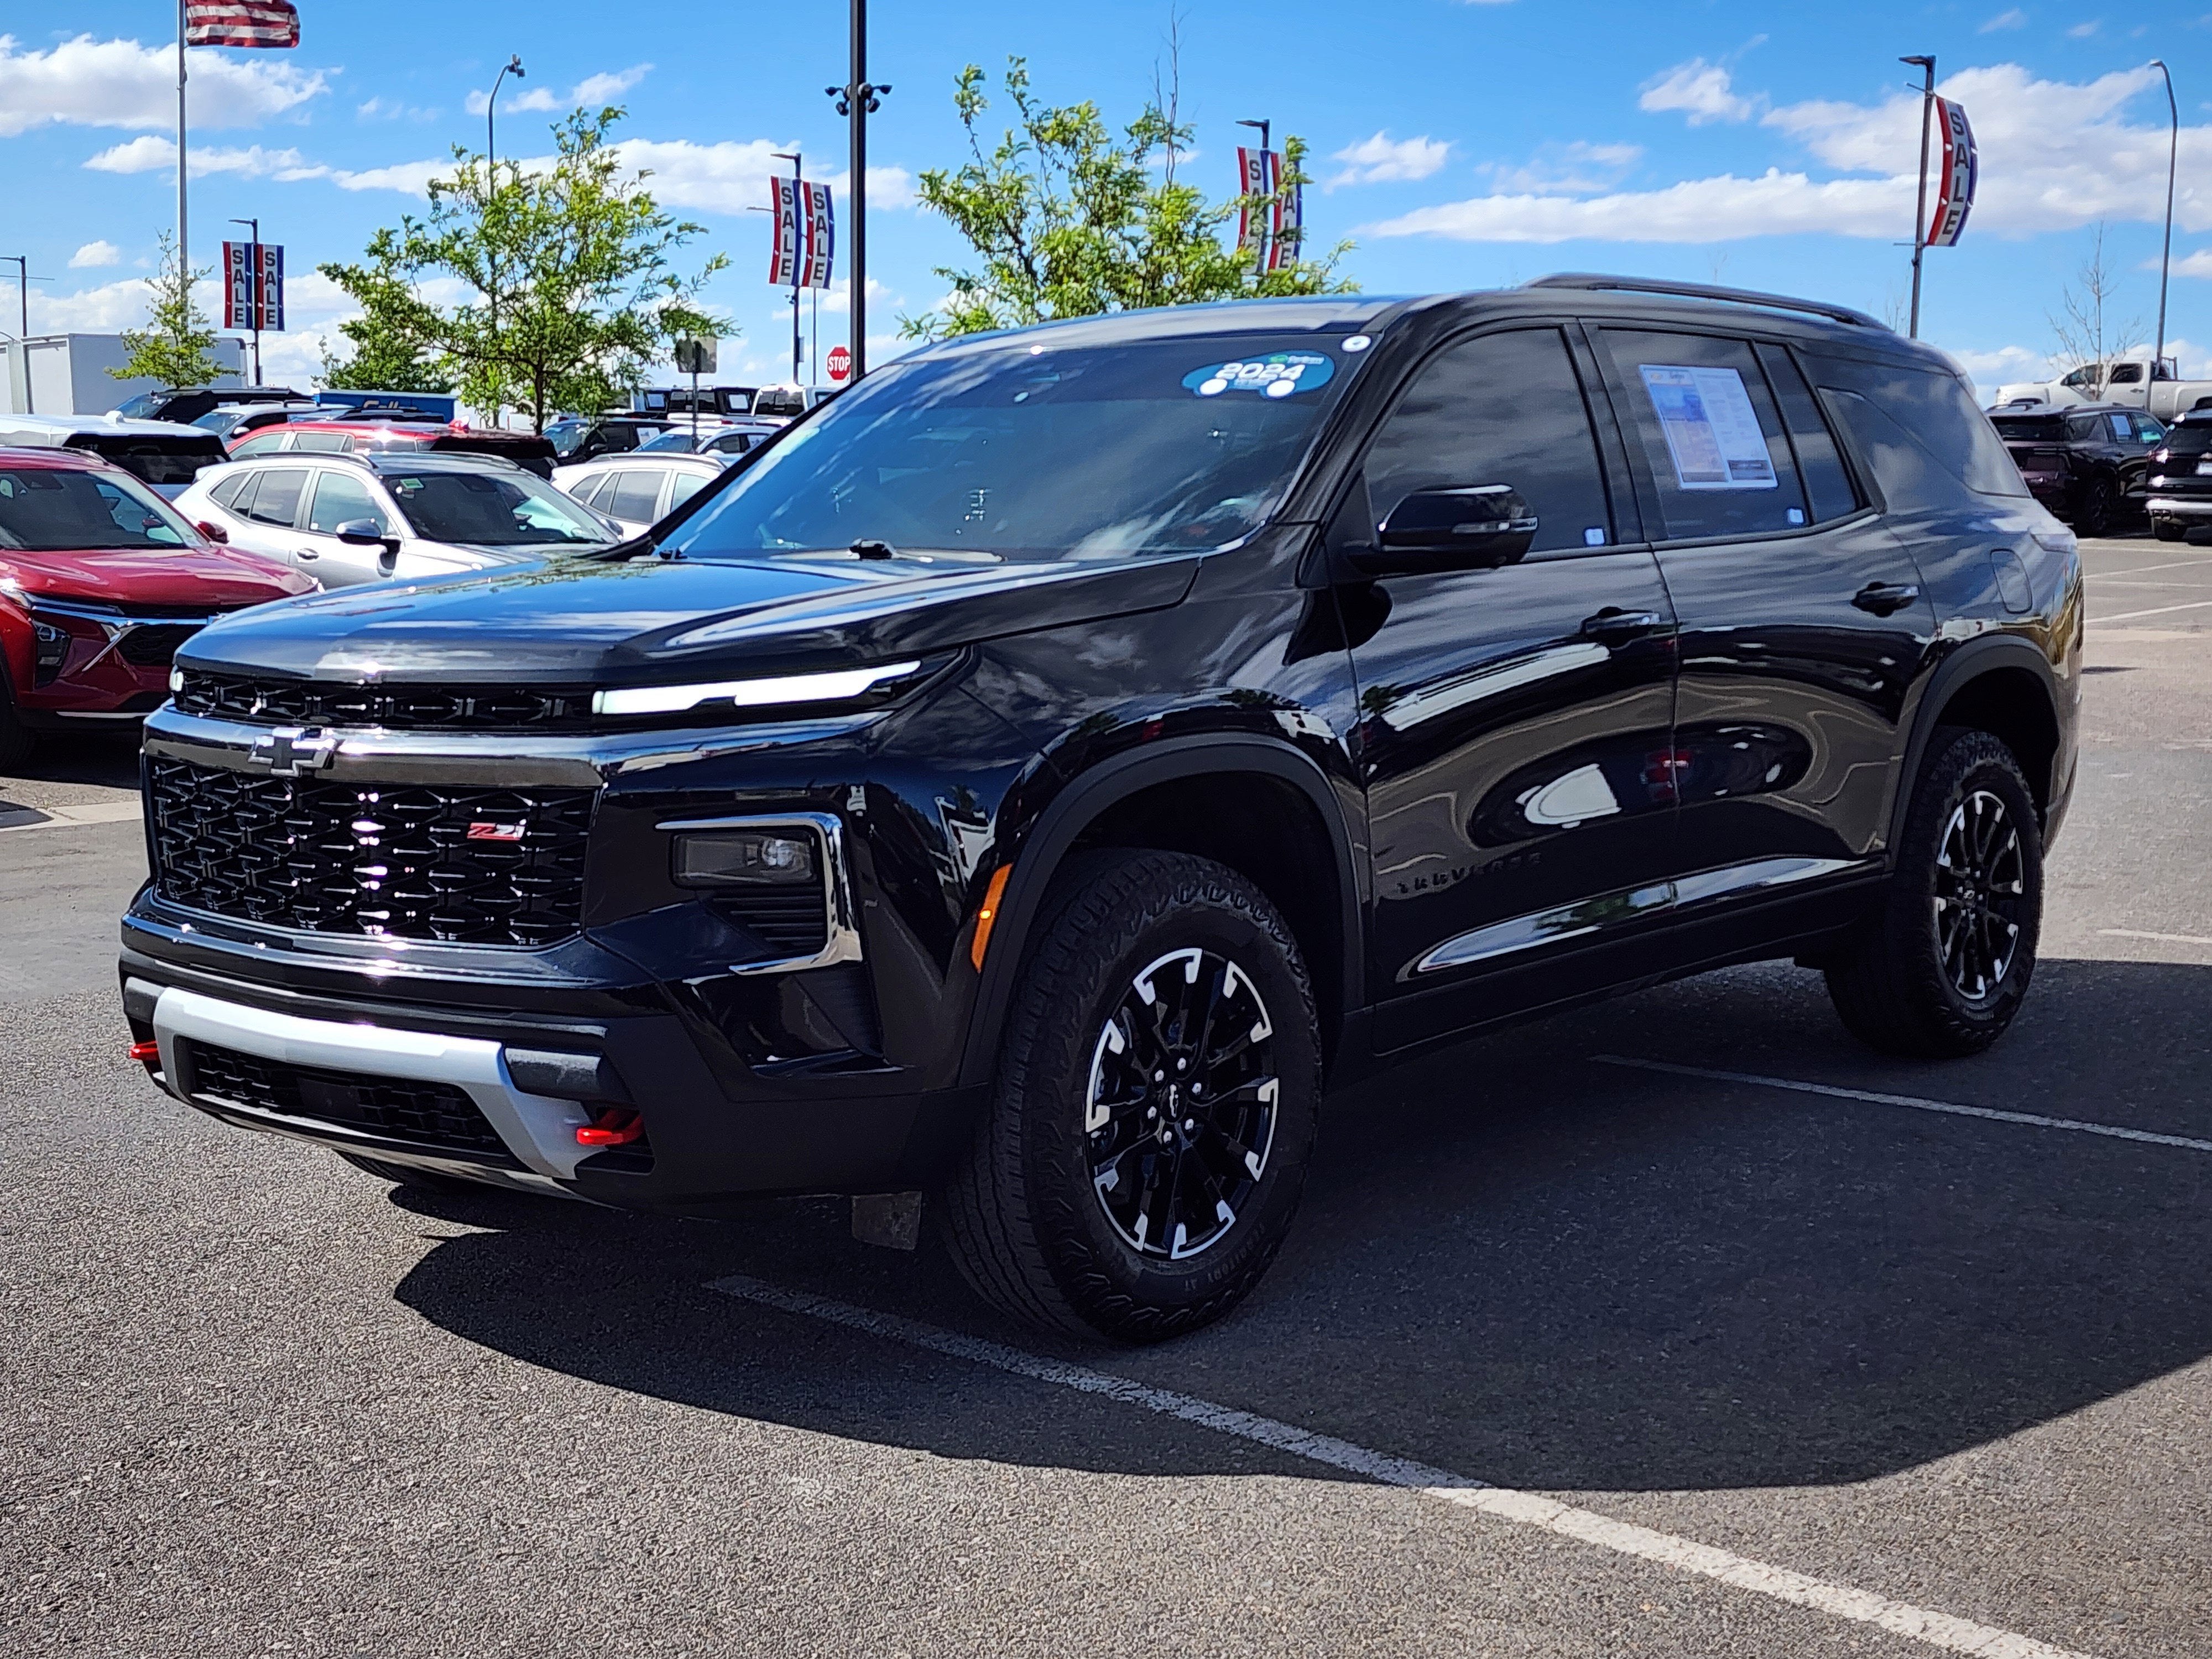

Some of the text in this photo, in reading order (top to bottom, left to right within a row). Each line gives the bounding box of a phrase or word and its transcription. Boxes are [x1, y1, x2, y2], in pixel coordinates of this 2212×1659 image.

[1942, 112, 1970, 235] SALE
[780, 186, 795, 277] SALE
[813, 191, 828, 280] SALE
[232, 249, 245, 322] SALE
[264, 251, 276, 324] SALE
[828, 356, 851, 372] STOP
[1214, 362, 1306, 380] 2024
